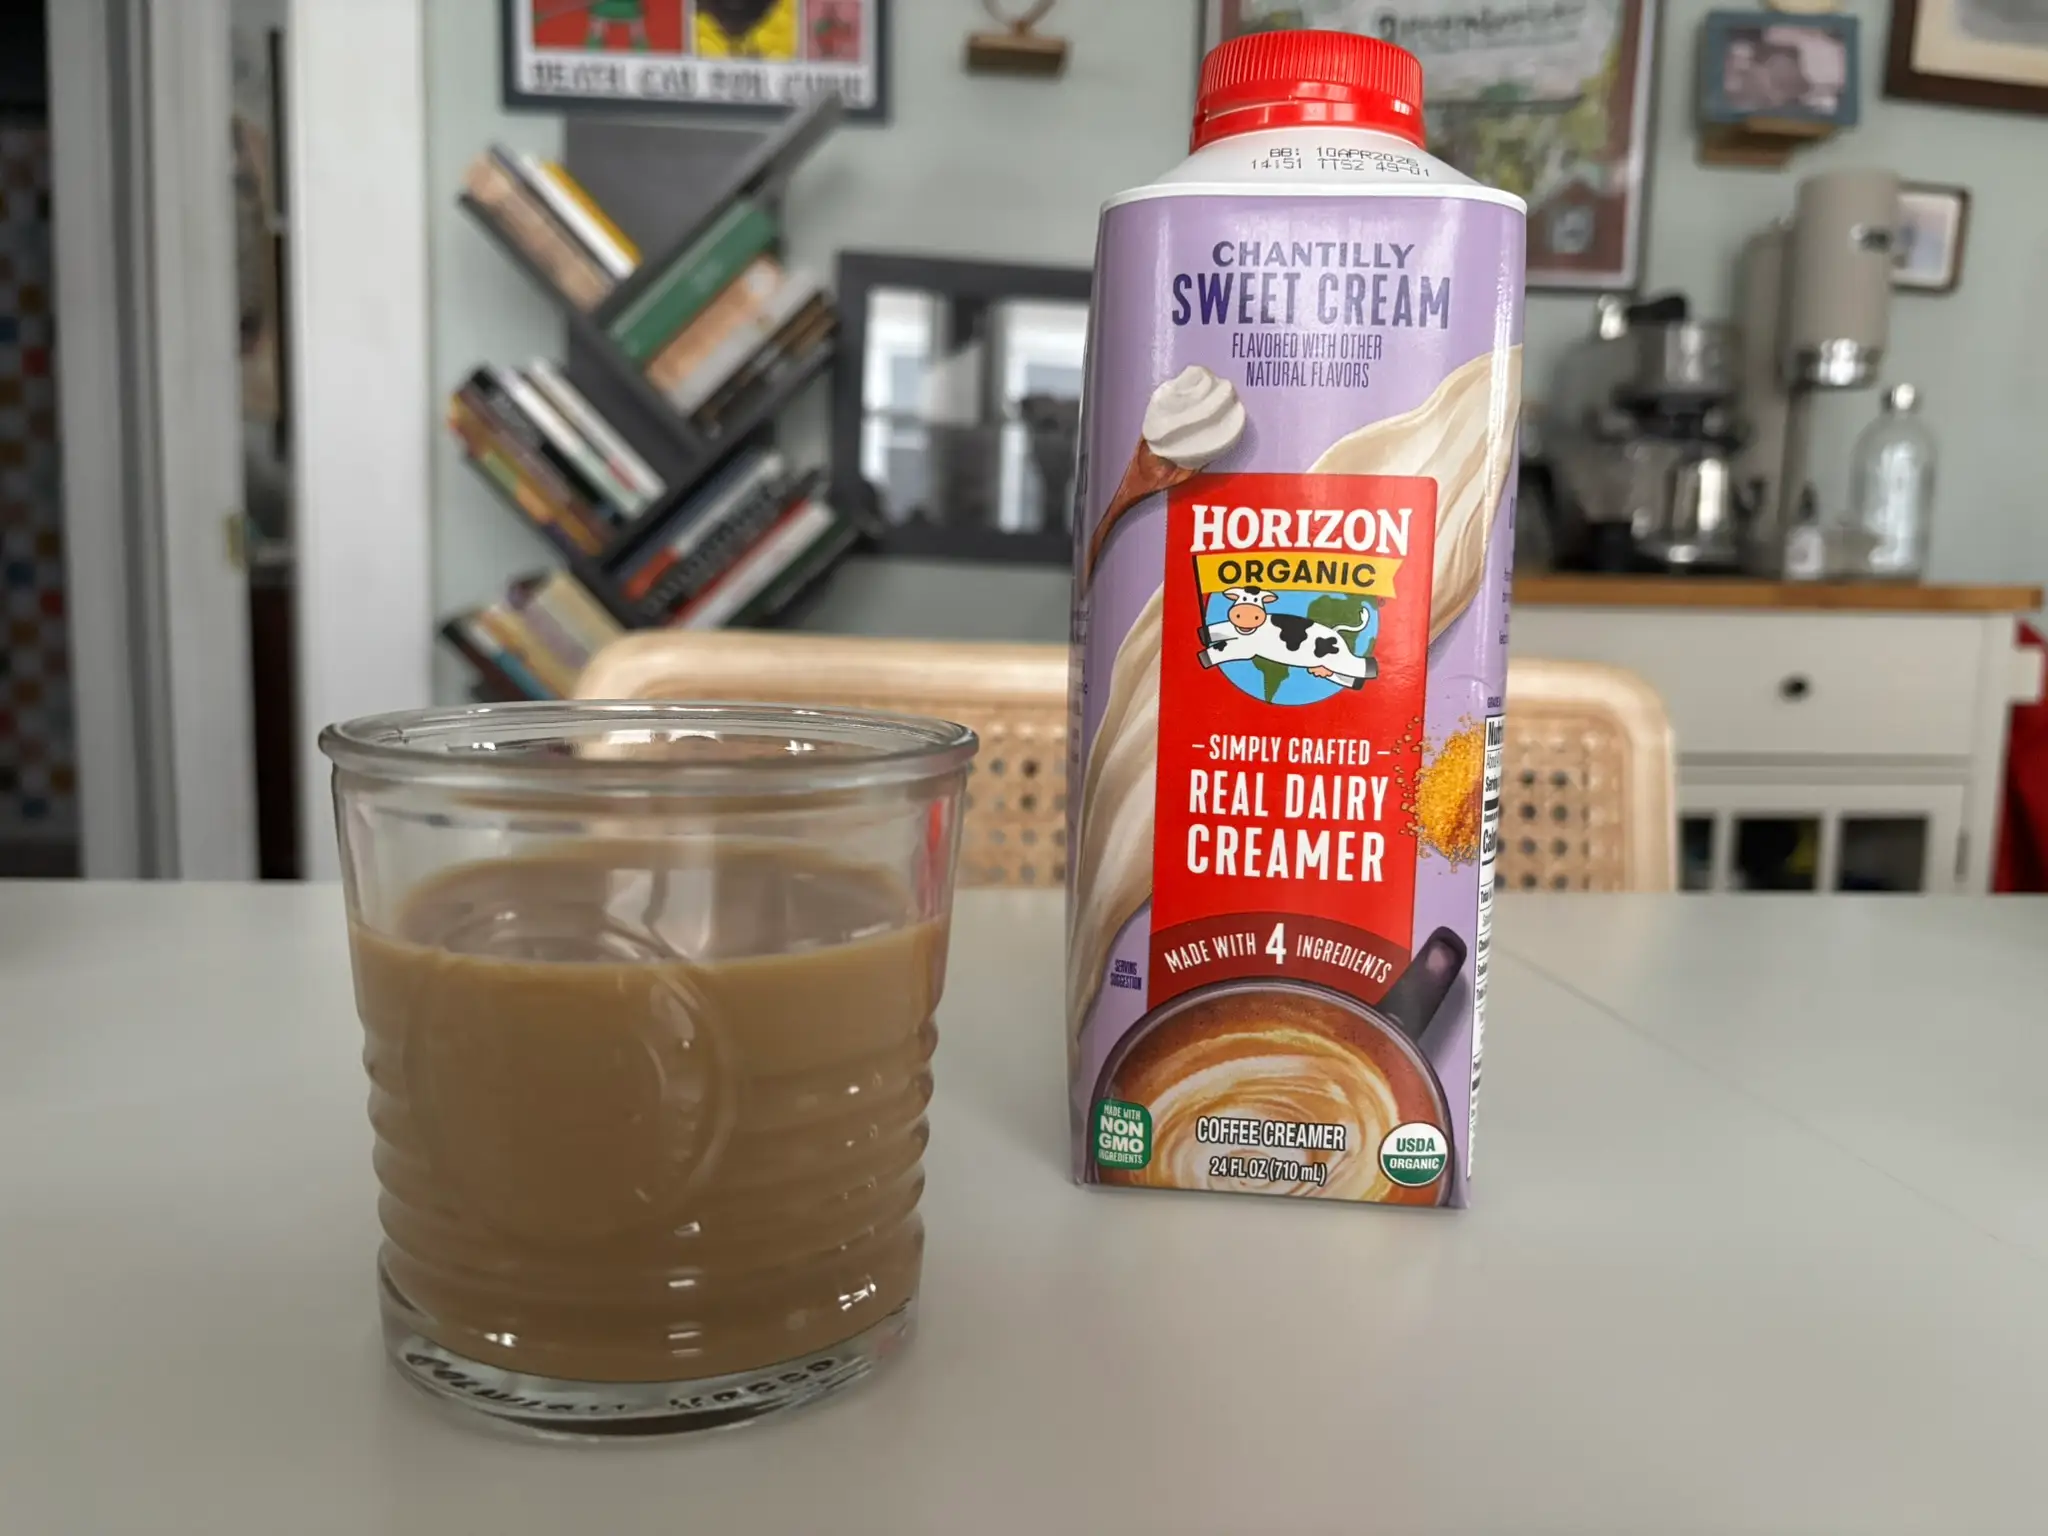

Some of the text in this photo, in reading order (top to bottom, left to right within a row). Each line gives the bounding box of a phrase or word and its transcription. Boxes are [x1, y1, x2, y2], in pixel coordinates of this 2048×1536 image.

[1251, 157, 1303, 170] 14:51
[1316, 145, 1419, 167] 10APR2026
[1211, 240, 1416, 269] CHANTILLY
[1171, 272, 1451, 330] SWEET CREAM
[1231, 332, 1383, 361] FLAVORED WITH OTHER
[1245, 360, 1370, 388] NATURAL FLAVORS
[1189, 503, 1413, 557] HORIZON
[1217, 558, 1377, 588] ORGANIC
[1208, 733, 1371, 766] SIMPLY CRAFTED
[1188, 768, 1389, 822] REAL DAIRY
[1186, 823, 1386, 883] CREAMER
[1163, 922, 1394, 985] MADE WITH 4 INGREDIENTS
[1099, 1114, 1144, 1139] NON
[1103, 1103, 1142, 1121] MADE WITH
[1098, 1131, 1145, 1154] GMO
[1196, 1115, 1347, 1151] COFFEE CREAMER
[1395, 1136, 1436, 1153] USDA
[1098, 1148, 1144, 1165] INGREDIENTS
[1388, 1156, 1441, 1171] ORGANIC
[1209, 1156, 1328, 1187] 24 FL OZ (710 mL)
